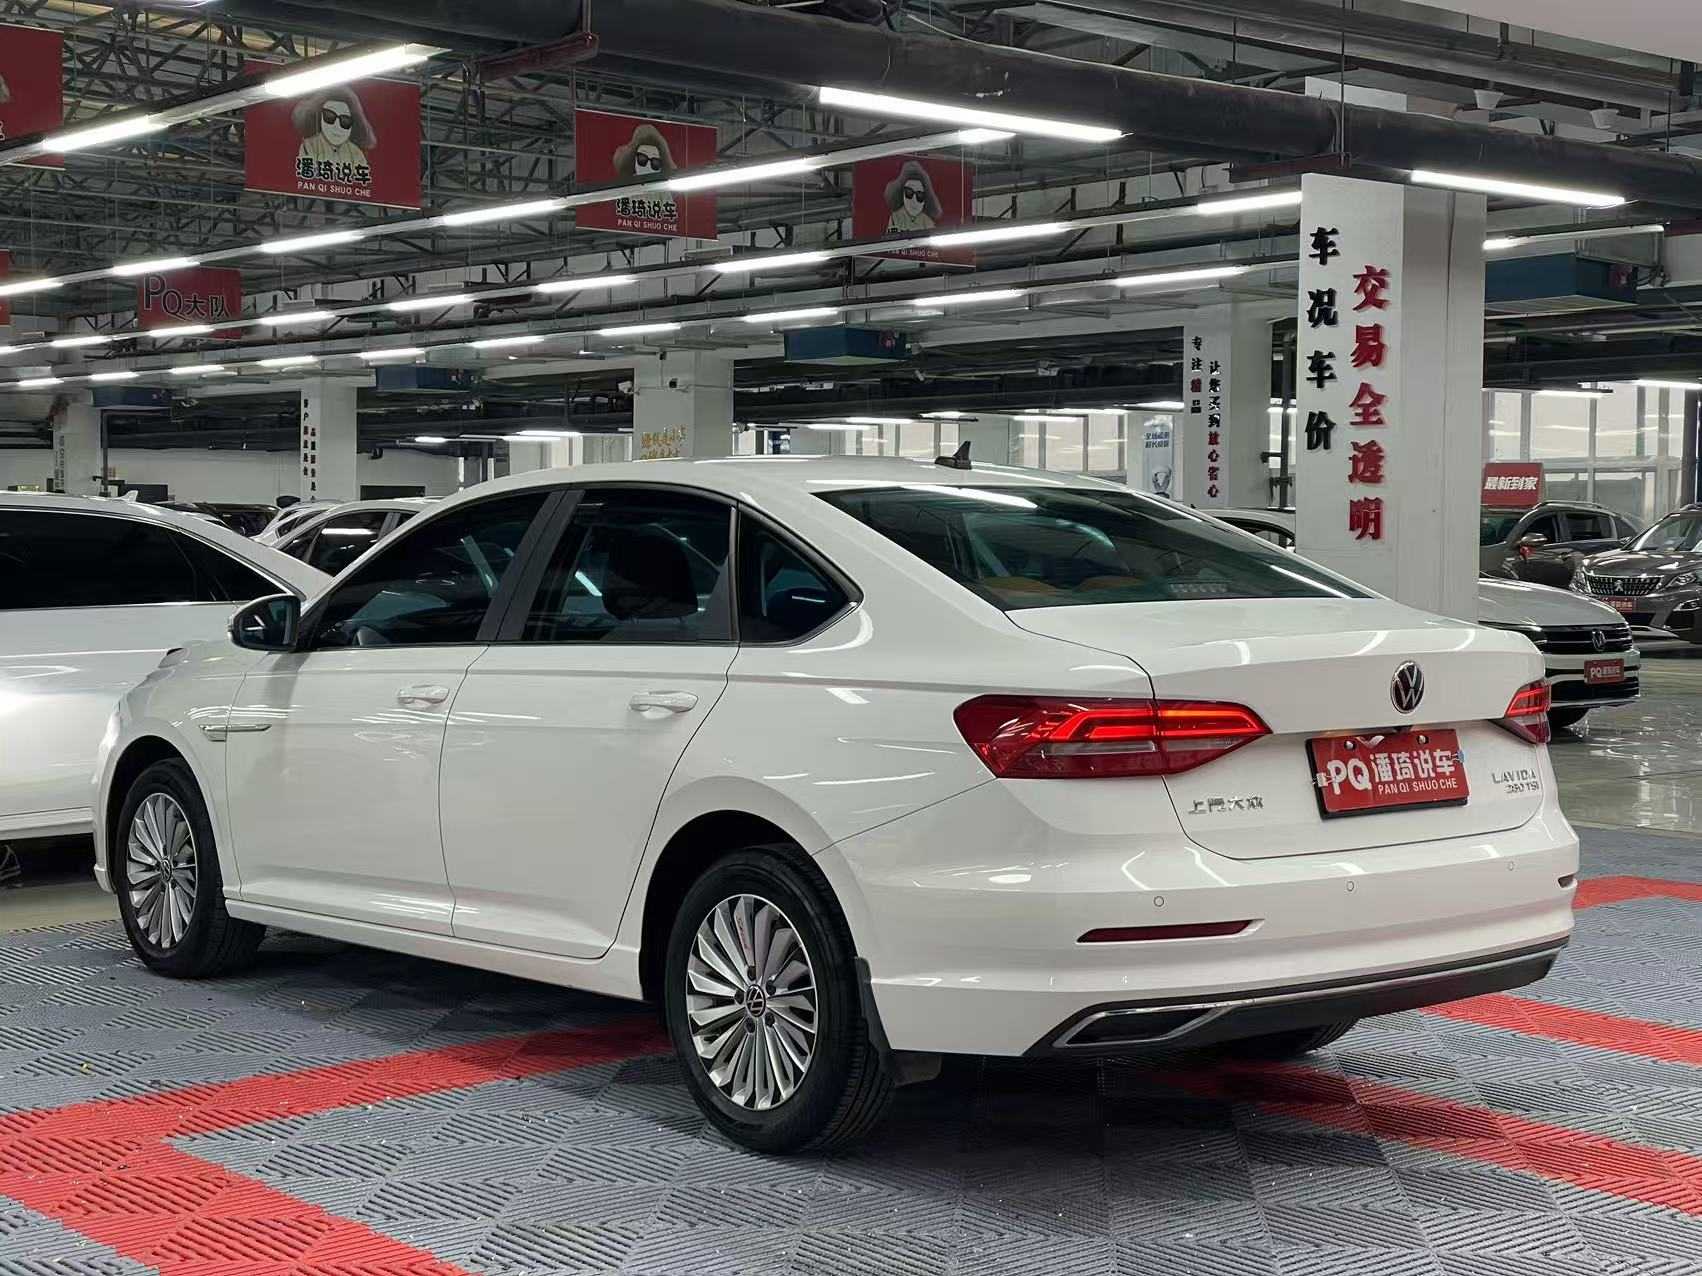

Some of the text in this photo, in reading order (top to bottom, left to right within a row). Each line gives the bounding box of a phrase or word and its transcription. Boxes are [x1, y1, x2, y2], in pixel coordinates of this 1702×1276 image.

[296, 157, 372, 186] 潘琦说车
[297, 181, 371, 197] PAN QI SHUO CHE
[617, 219, 632, 228] PAN
[663, 223, 677, 231] CHE
[1305, 226, 1341, 450] 车况车价
[1347, 265, 1392, 541] 交易全透明
[1327, 749, 1456, 795] PQ 潘琦说车
[1491, 769, 1536, 784] LAVIDA
[1378, 779, 1458, 795] PAN QI SHUO CHE
